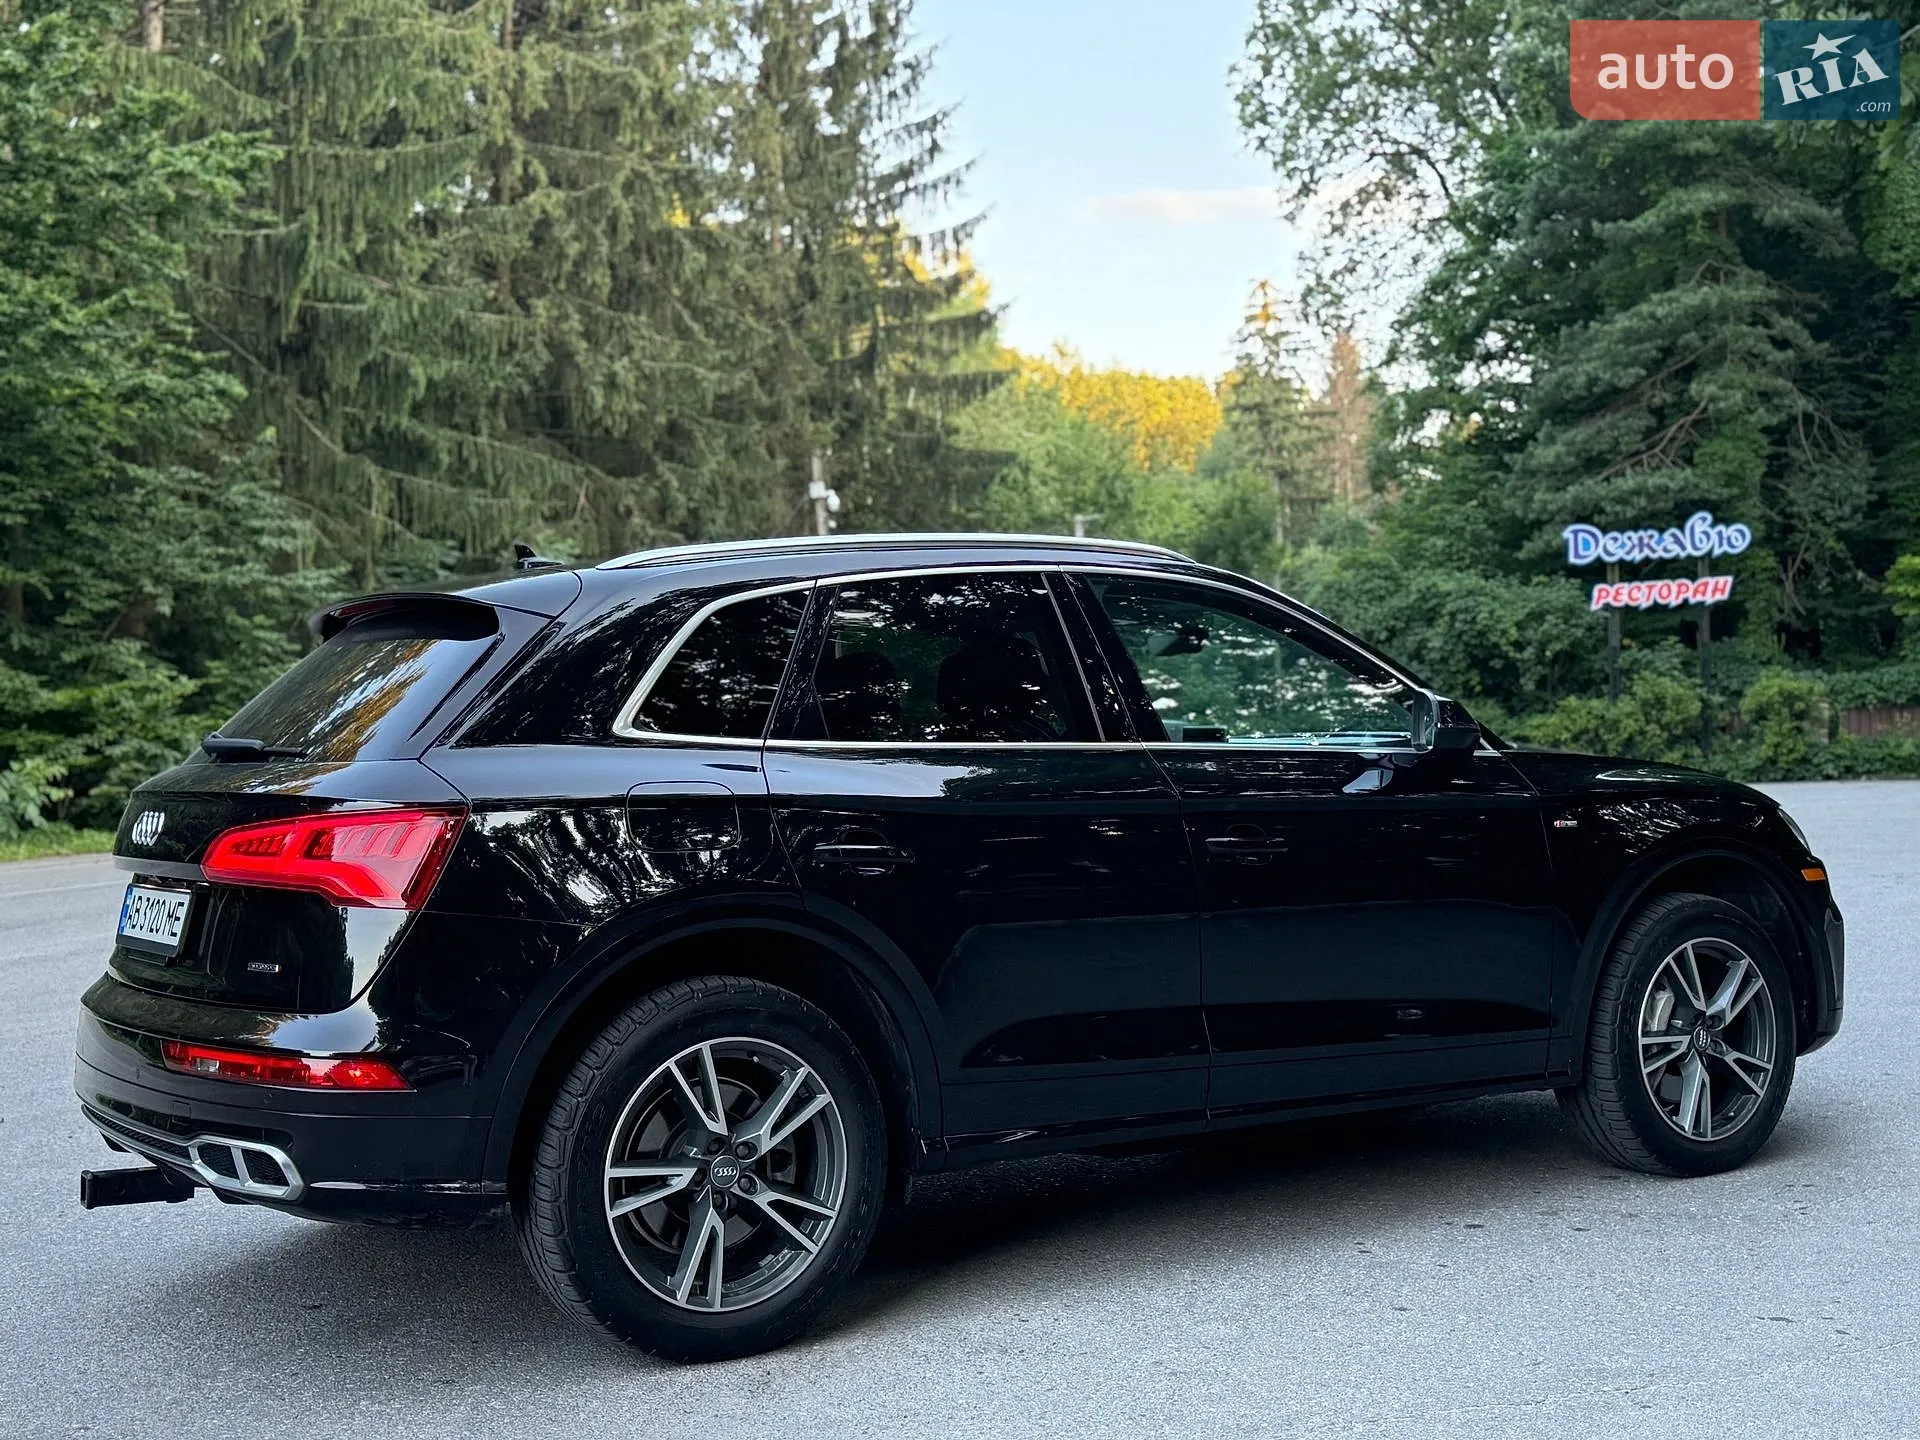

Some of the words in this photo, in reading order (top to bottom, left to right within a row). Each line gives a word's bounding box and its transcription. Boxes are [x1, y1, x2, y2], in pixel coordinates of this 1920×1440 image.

[1591, 575, 1734, 611] РЕСТОРАН
[126, 895, 143, 929] AB
[139, 897, 166, 933] 3120
[162, 900, 185, 937] ME
